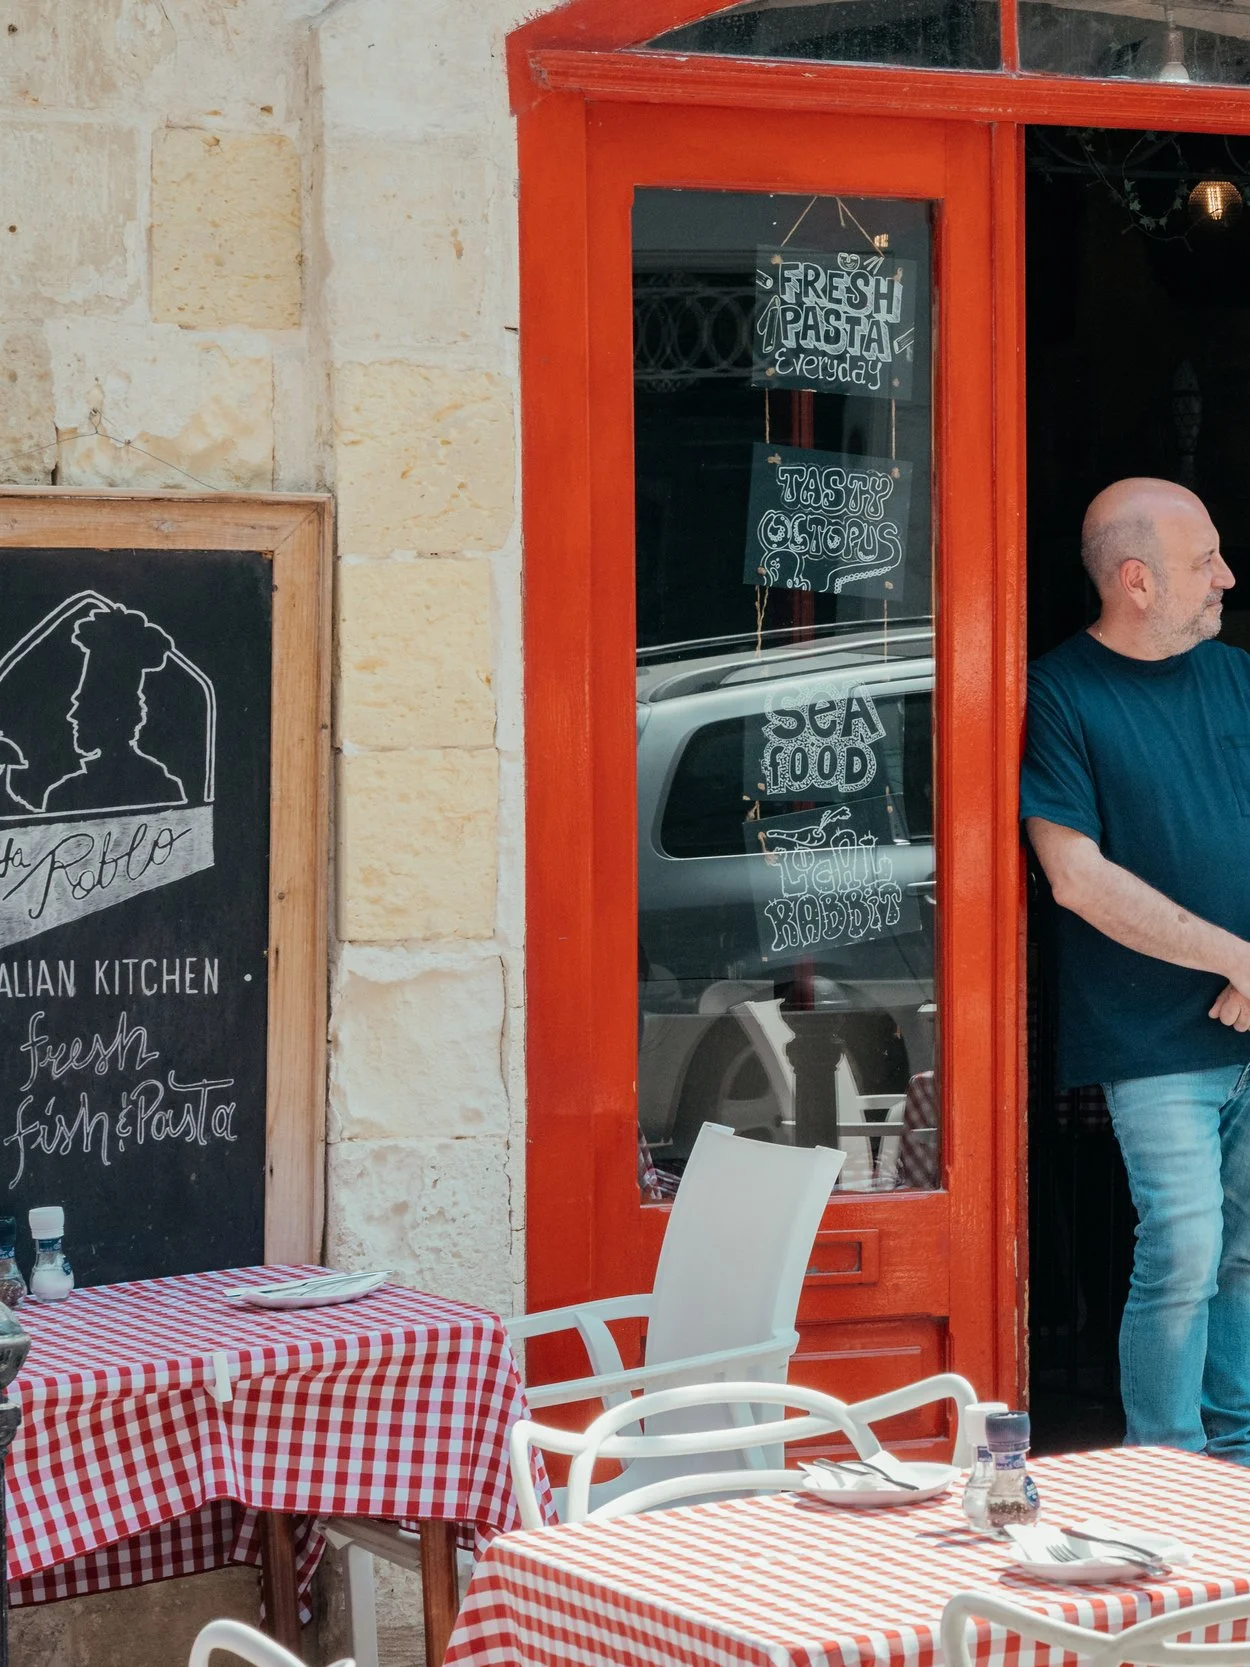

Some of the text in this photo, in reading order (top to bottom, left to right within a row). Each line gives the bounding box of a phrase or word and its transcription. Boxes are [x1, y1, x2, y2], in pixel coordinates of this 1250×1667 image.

[779, 262, 903, 323] FRESH
[779, 305, 893, 362] PASTA
[775, 347, 882, 390] Everyday
[777, 465, 893, 520] TASTY
[758, 511, 902, 563] OCTOPUS
[95, 958, 219, 996] KITCHEN
[20, 1011, 160, 1092] fresh
[3, 1092, 111, 1190] fish
